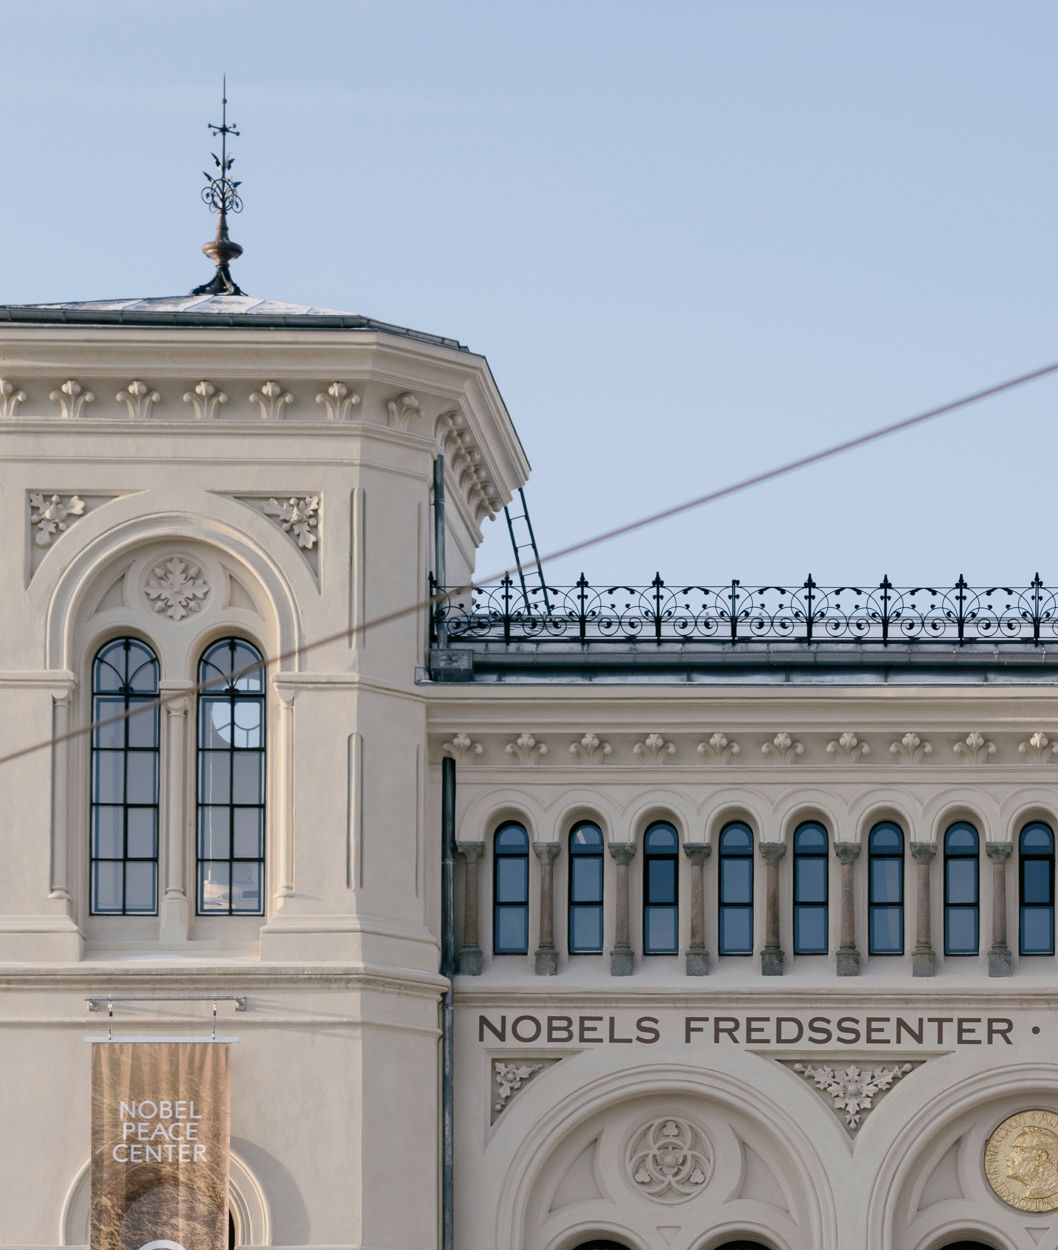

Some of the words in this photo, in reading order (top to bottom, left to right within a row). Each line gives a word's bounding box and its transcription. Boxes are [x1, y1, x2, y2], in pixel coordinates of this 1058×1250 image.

[478, 1014, 661, 1045] NOBELS
[684, 1016, 1014, 1046] FREDSSENTER
[118, 1099, 202, 1120] NOBEL
[122, 1122, 199, 1141] PEACE
[111, 1143, 208, 1163] CENTER
